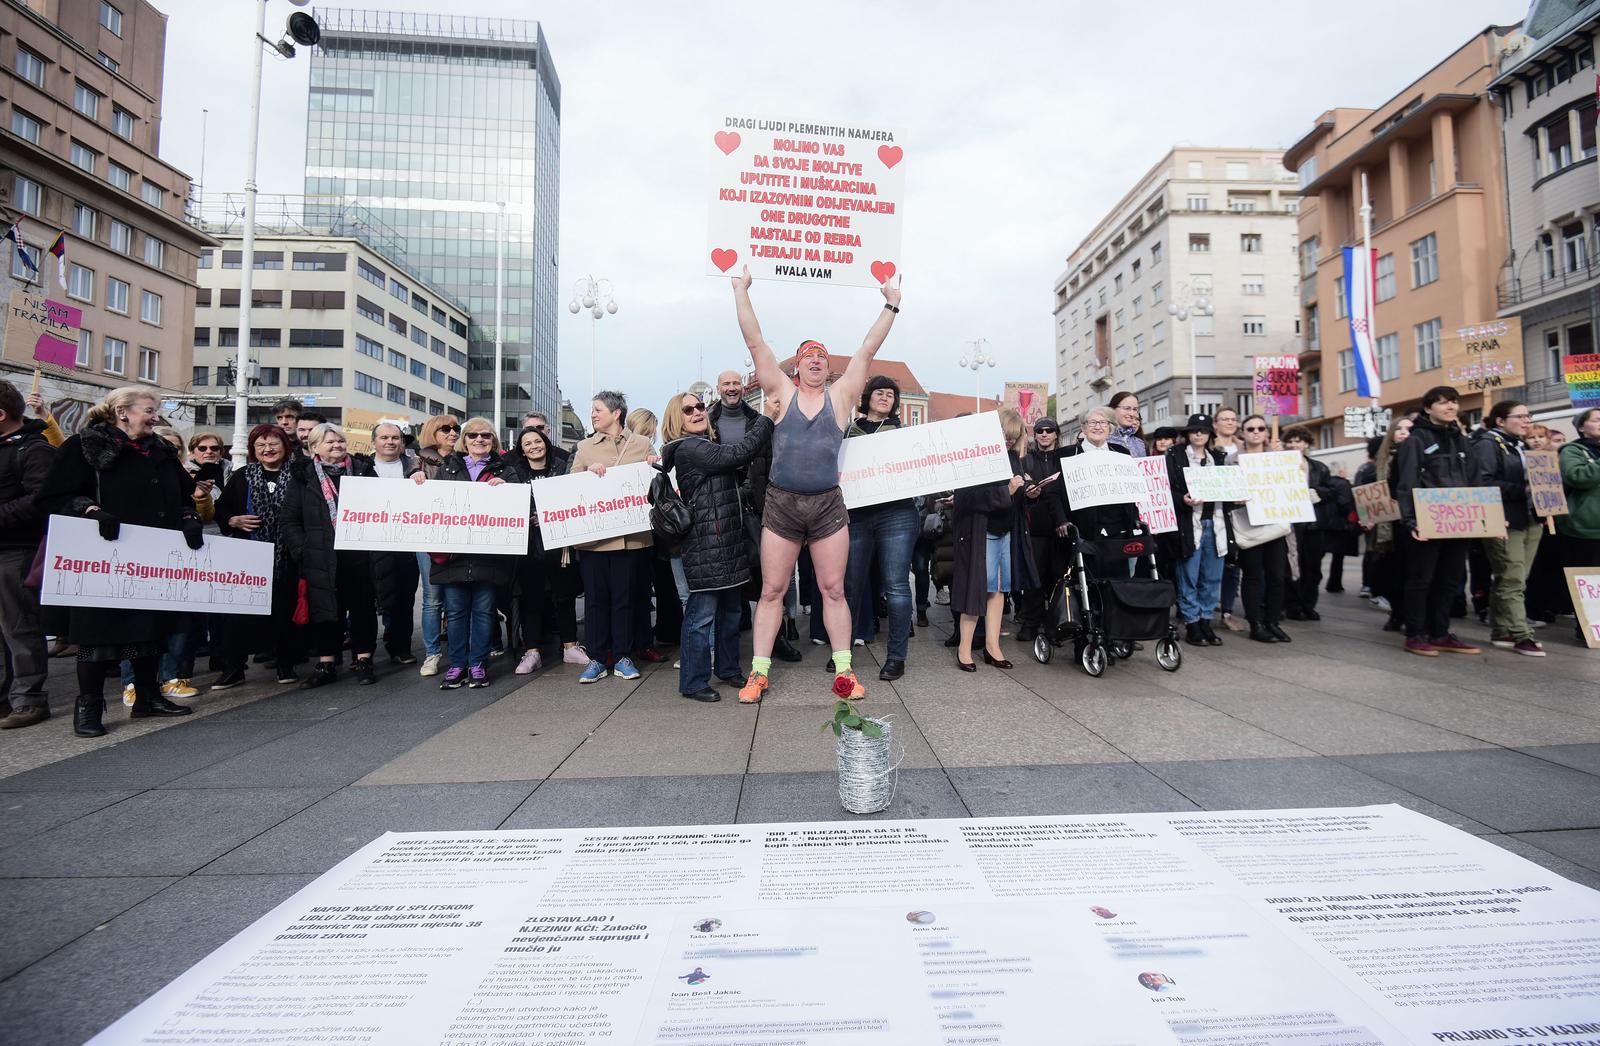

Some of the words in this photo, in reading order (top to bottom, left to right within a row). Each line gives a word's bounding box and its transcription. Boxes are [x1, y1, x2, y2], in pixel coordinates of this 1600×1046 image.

[725, 117, 756, 129] DRAGI
[759, 120, 786, 132] LJUDI
[789, 123, 845, 138] PLEMENITIH
[848, 128, 894, 142] NAMJERA
[774, 139, 820, 155] MOLIMO
[823, 143, 845, 156] VAS
[754, 155, 769, 168] DA
[772, 157, 810, 172] SVOJE
[812, 160, 863, 176] MOLITVE
[741, 172, 790, 188] UPUTITE
[793, 176, 797, 188] I
[800, 176, 877, 195] MUŠKARCIMA
[720, 188, 747, 202] KOJI
[750, 191, 813, 208] IZAZOVNIM
[816, 196, 895, 215] ODIJEVANJEM
[761, 209, 785, 222] ONE
[788, 212, 850, 228] DRUGOTNE
[751, 227, 802, 242] NASTALE
[805, 231, 821, 243] OD
[824, 233, 861, 247] REBRA
[750, 245, 802, 260] TJERAJU
[805, 249, 821, 261] NA
[824, 251, 854, 264] BLUD
[775, 265, 808, 277] HVALA
[810, 267, 832, 279] VAM
[24, 298, 69, 319] NISAM
[1466, 339, 1500, 354] PRAVA
[1468, 376, 1502, 390] PRAVA
[878, 443, 1002, 476] #SigurnoMjestoZaŽene
[342, 509, 389, 524] Zagreb
[392, 511, 525, 528] #SafePlace4Women
[543, 504, 586, 524] Zagreb
[1428, 504, 1486, 520] SPASITI
[54, 556, 111, 574] Zagreb
[114, 562, 268, 587] #SigurnoMjestoZaŽene
[1511, 886, 1552, 894] godina
[1326, 904, 1394, 912] Mjesecima
[1386, 911, 1452, 919] nagovorao
[342, 914, 372, 922] Zbog
[374, 914, 426, 922] ubojstva
[285, 924, 350, 932] partnerice
[601, 924, 648, 932] Zatočio
[274, 933, 319, 941] godina
[512, 935, 585, 943] nevjenčanu
[504, 945, 545, 953] mučio
[546, 945, 562, 953] ju
[516, 990, 557, 998] napadao
[515, 1022, 566, 1030] partnericu
[1432, 1029, 1509, 1043] PRIJAVIO
[1506, 1027, 1535, 1038] SE
[1530, 1026, 1549, 1037] U
